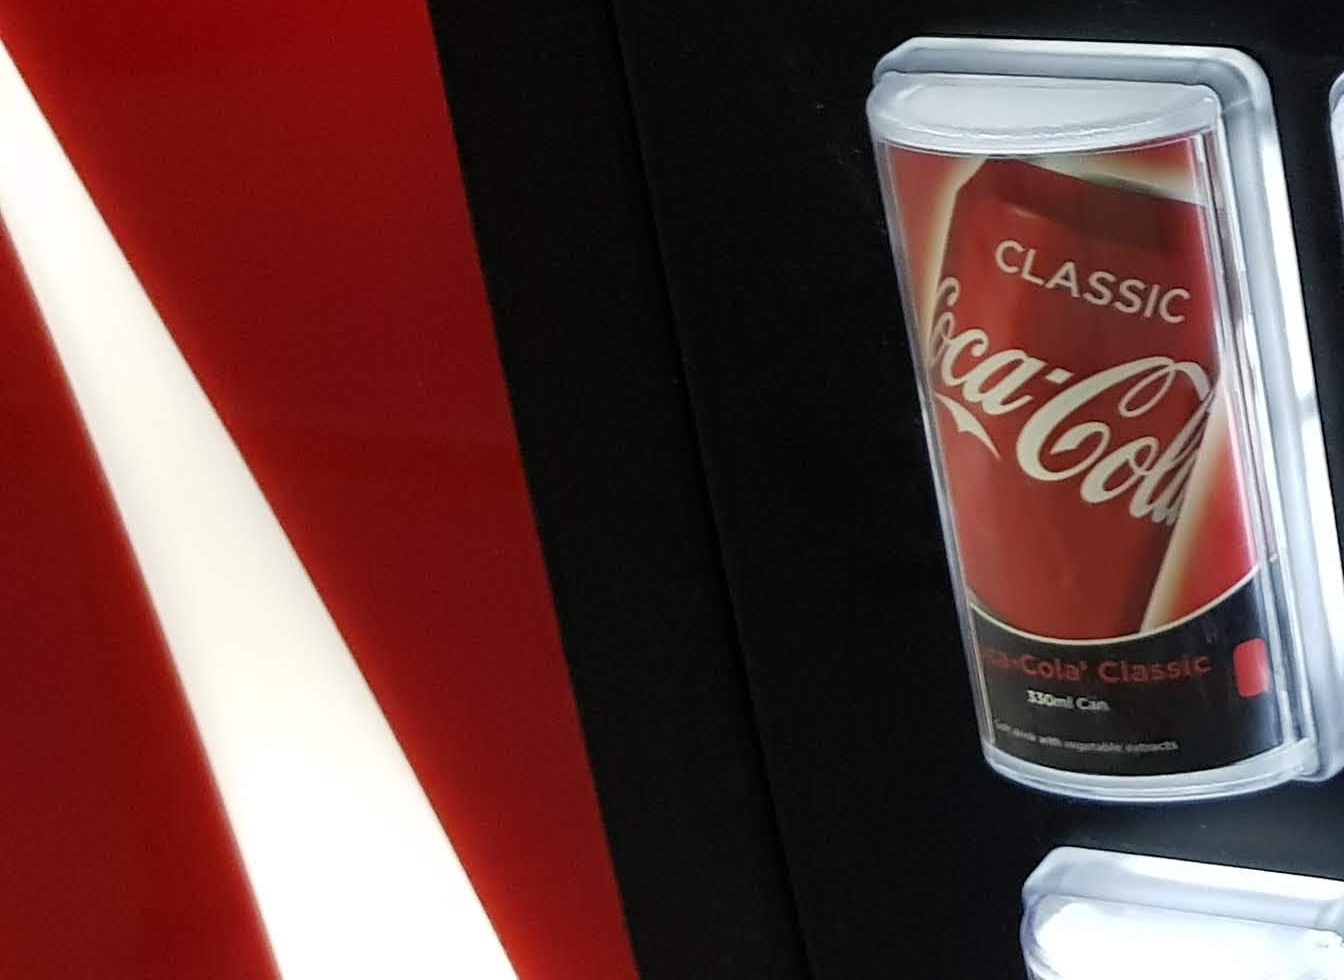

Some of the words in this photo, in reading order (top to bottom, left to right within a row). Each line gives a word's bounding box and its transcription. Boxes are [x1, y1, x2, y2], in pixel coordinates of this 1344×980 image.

[994, 239, 1191, 325] CLASSIC
[1097, 653, 1212, 684] Classic
[1025, 688, 1074, 710] 330ml
[1076, 696, 1112, 713] Can
